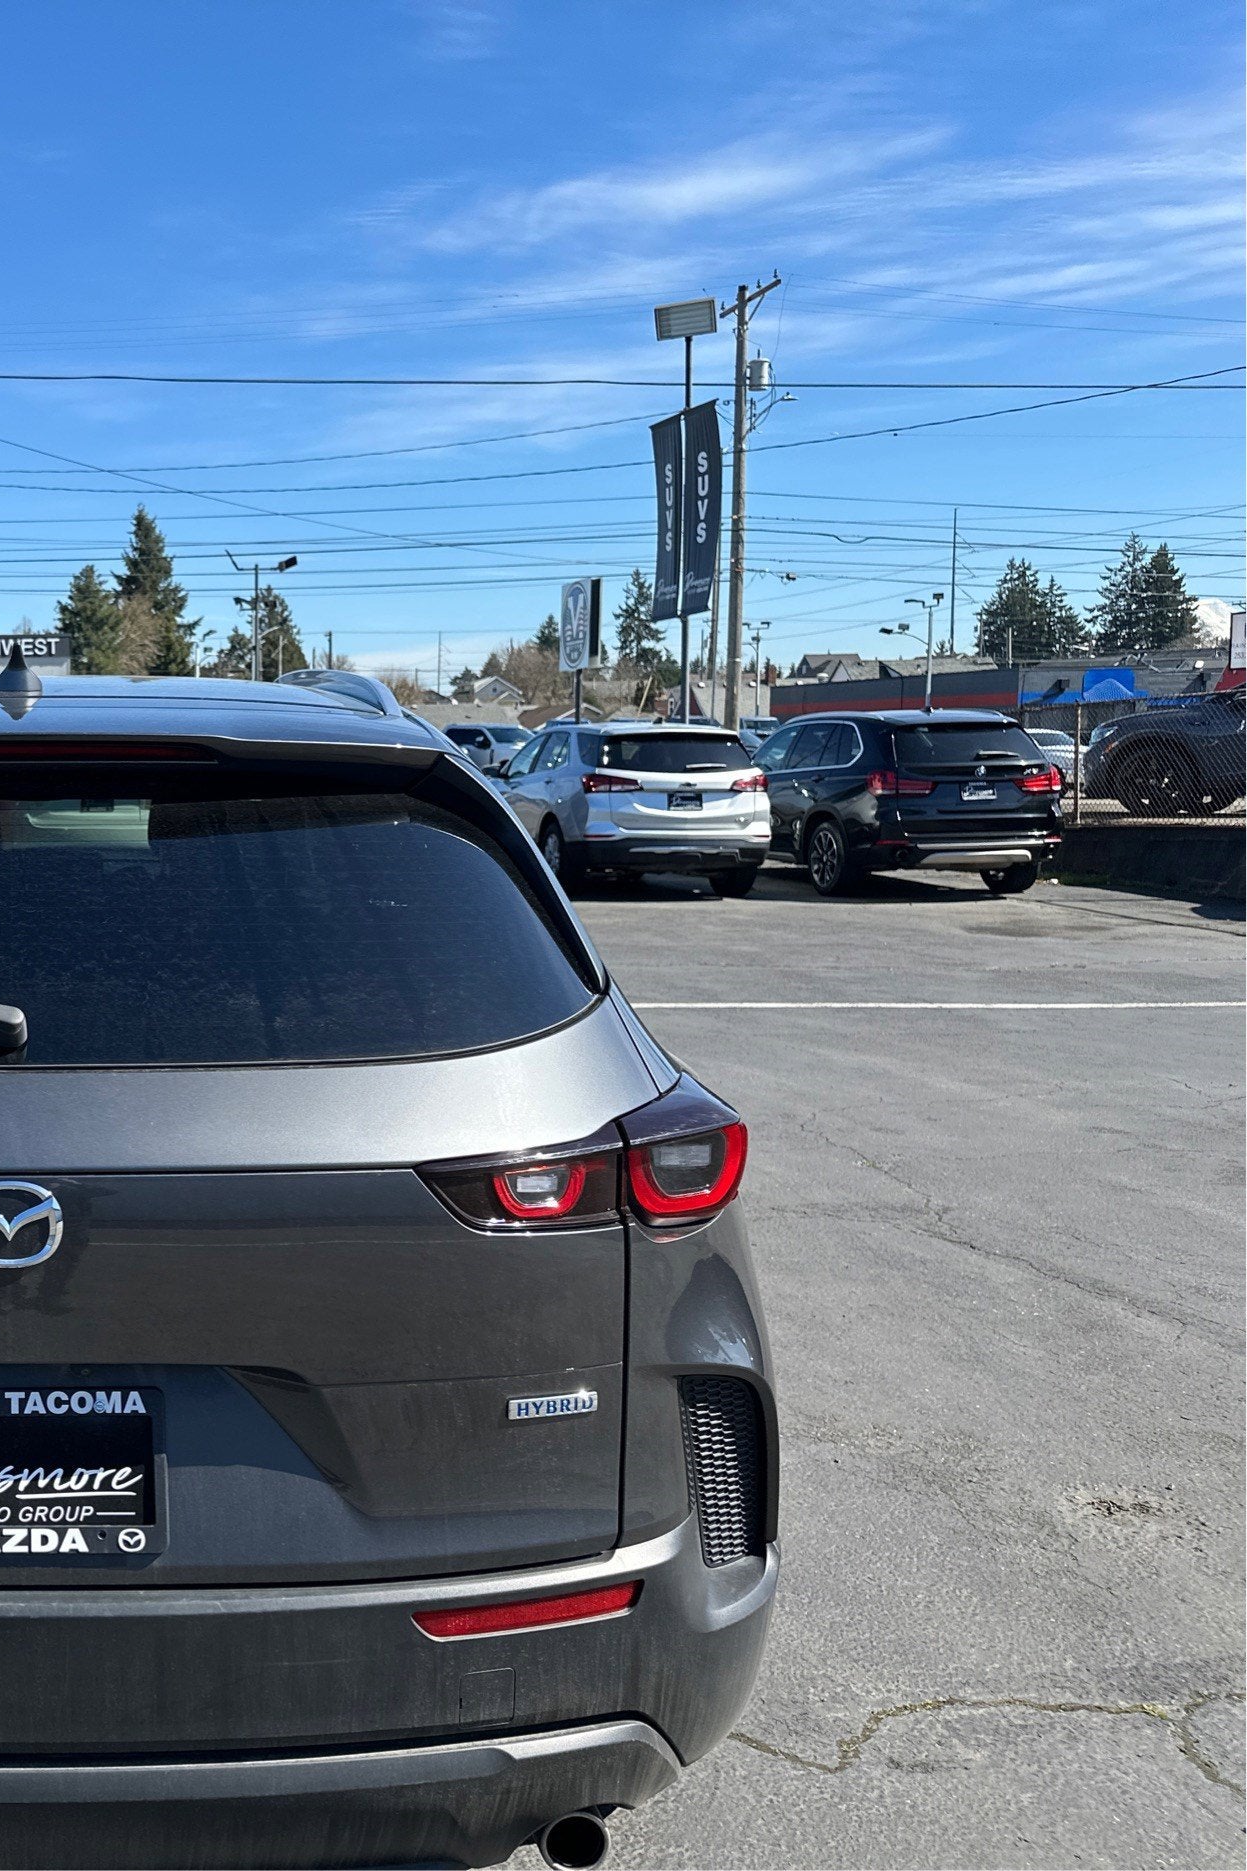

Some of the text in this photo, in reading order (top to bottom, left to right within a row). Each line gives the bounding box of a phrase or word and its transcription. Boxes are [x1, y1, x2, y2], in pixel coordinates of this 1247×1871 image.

[665, 463, 673, 552] SUVS
[696, 451, 709, 544] SUVS
[4, 1391, 146, 1415] TACOMA
[517, 1396, 593, 1417] HYBRID
[18, 1505, 94, 1523] GROUP
